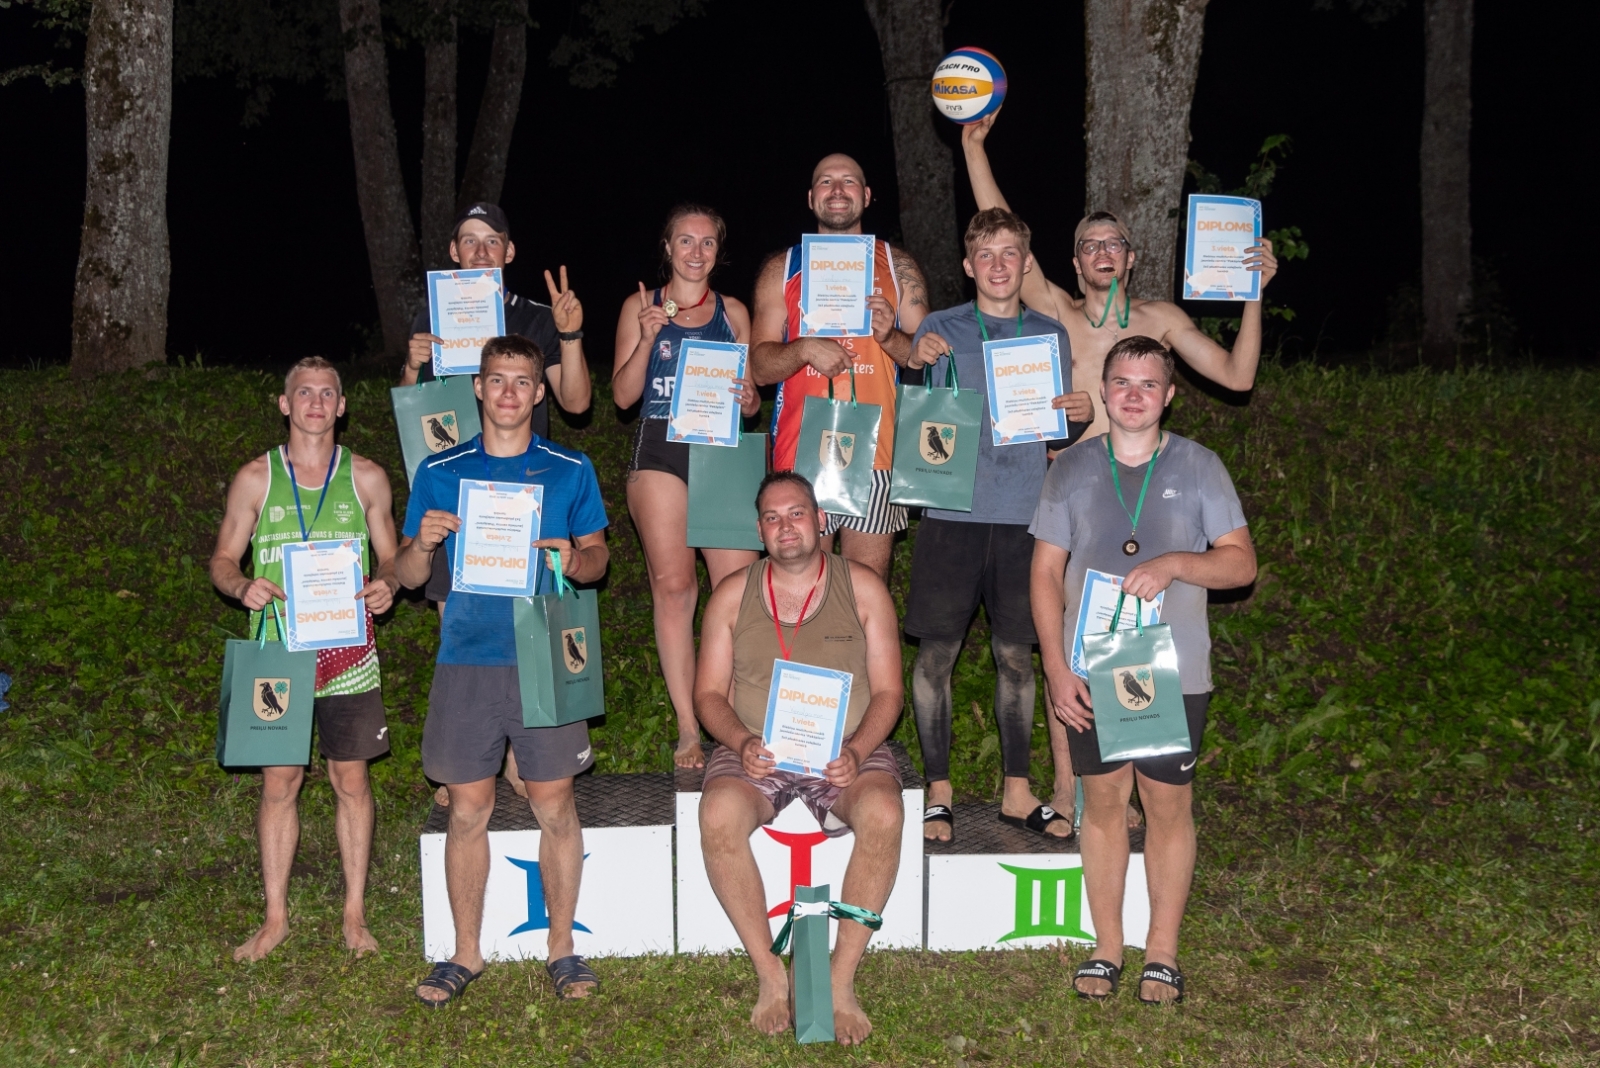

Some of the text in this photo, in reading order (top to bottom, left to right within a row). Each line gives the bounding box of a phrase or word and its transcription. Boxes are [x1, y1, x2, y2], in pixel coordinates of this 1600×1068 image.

[961, 64, 980, 73] PRO
[1197, 221, 1253, 232] DIPLOMS
[811, 260, 864, 271] DIPLOMS
[685, 365, 736, 379] DIPLOMS
[995, 362, 1051, 377] DIPLOMS
[465, 554, 526, 569] DIPLOMS
[297, 608, 355, 623] DIPLOMS
[779, 688, 838, 709] DIPLOMS
[1144, 970, 1172, 982] PUMA
